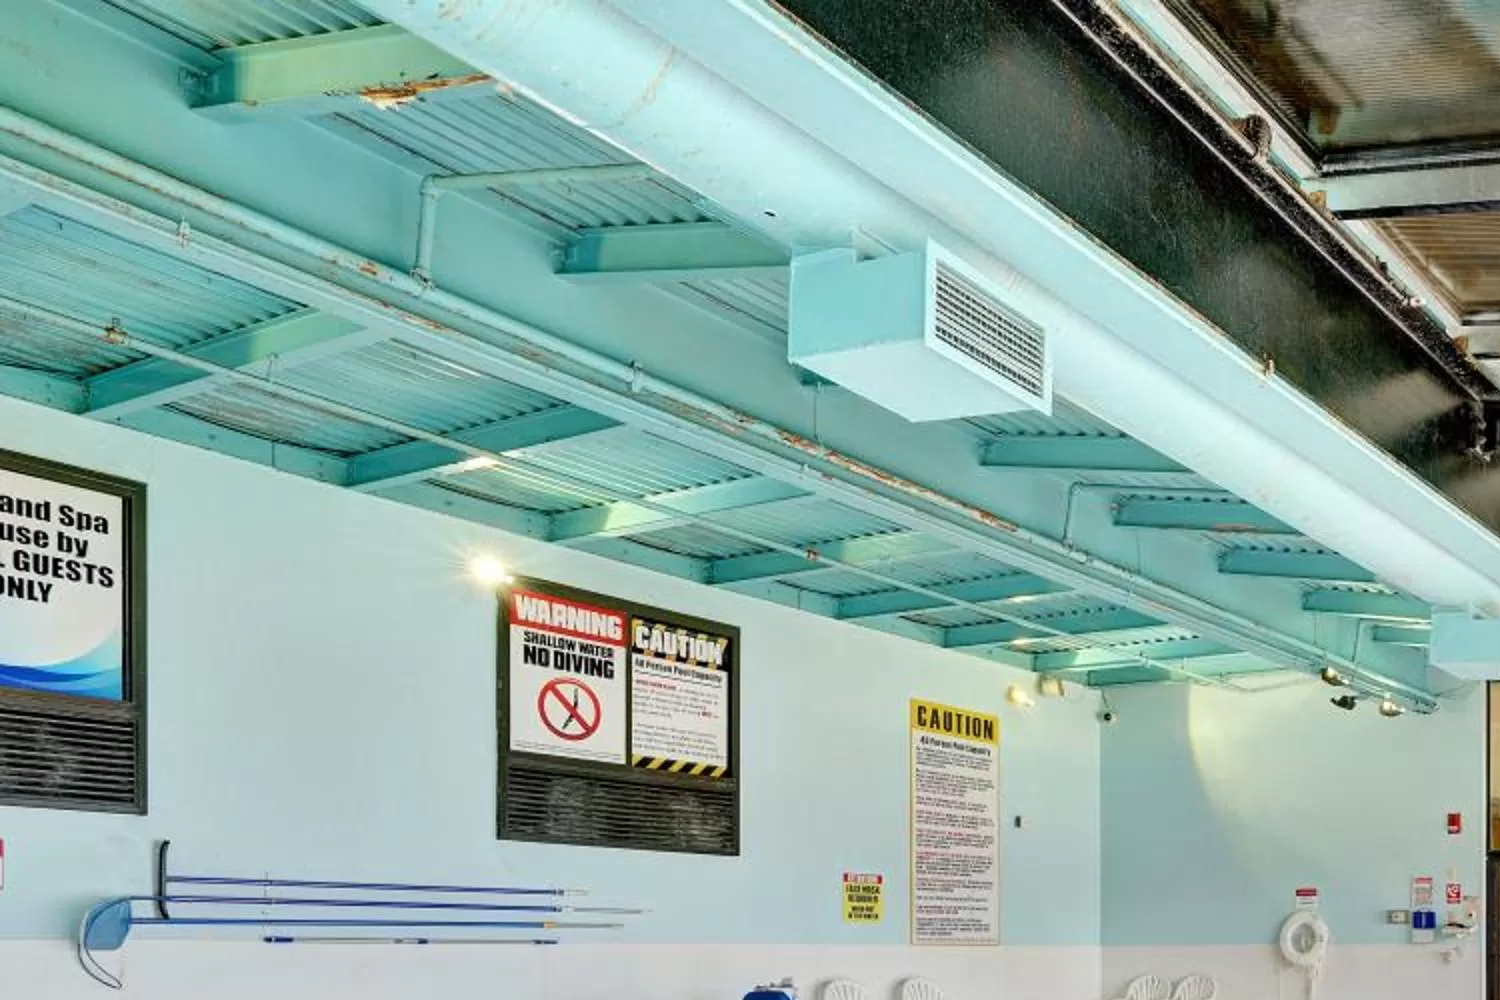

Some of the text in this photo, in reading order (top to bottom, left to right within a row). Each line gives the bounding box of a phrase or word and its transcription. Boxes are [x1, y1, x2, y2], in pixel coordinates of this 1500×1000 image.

[0, 495, 109, 535] and Spa
[0, 522, 89, 558] use by
[13, 549, 114, 589] GUESTS
[514, 594, 623, 640] WARNING
[523, 631, 614, 659] SHALLOW WATER
[523, 643, 615, 680] NO DIVING
[635, 625, 723, 667] CAUTION
[917, 705, 993, 740] CAUTION
